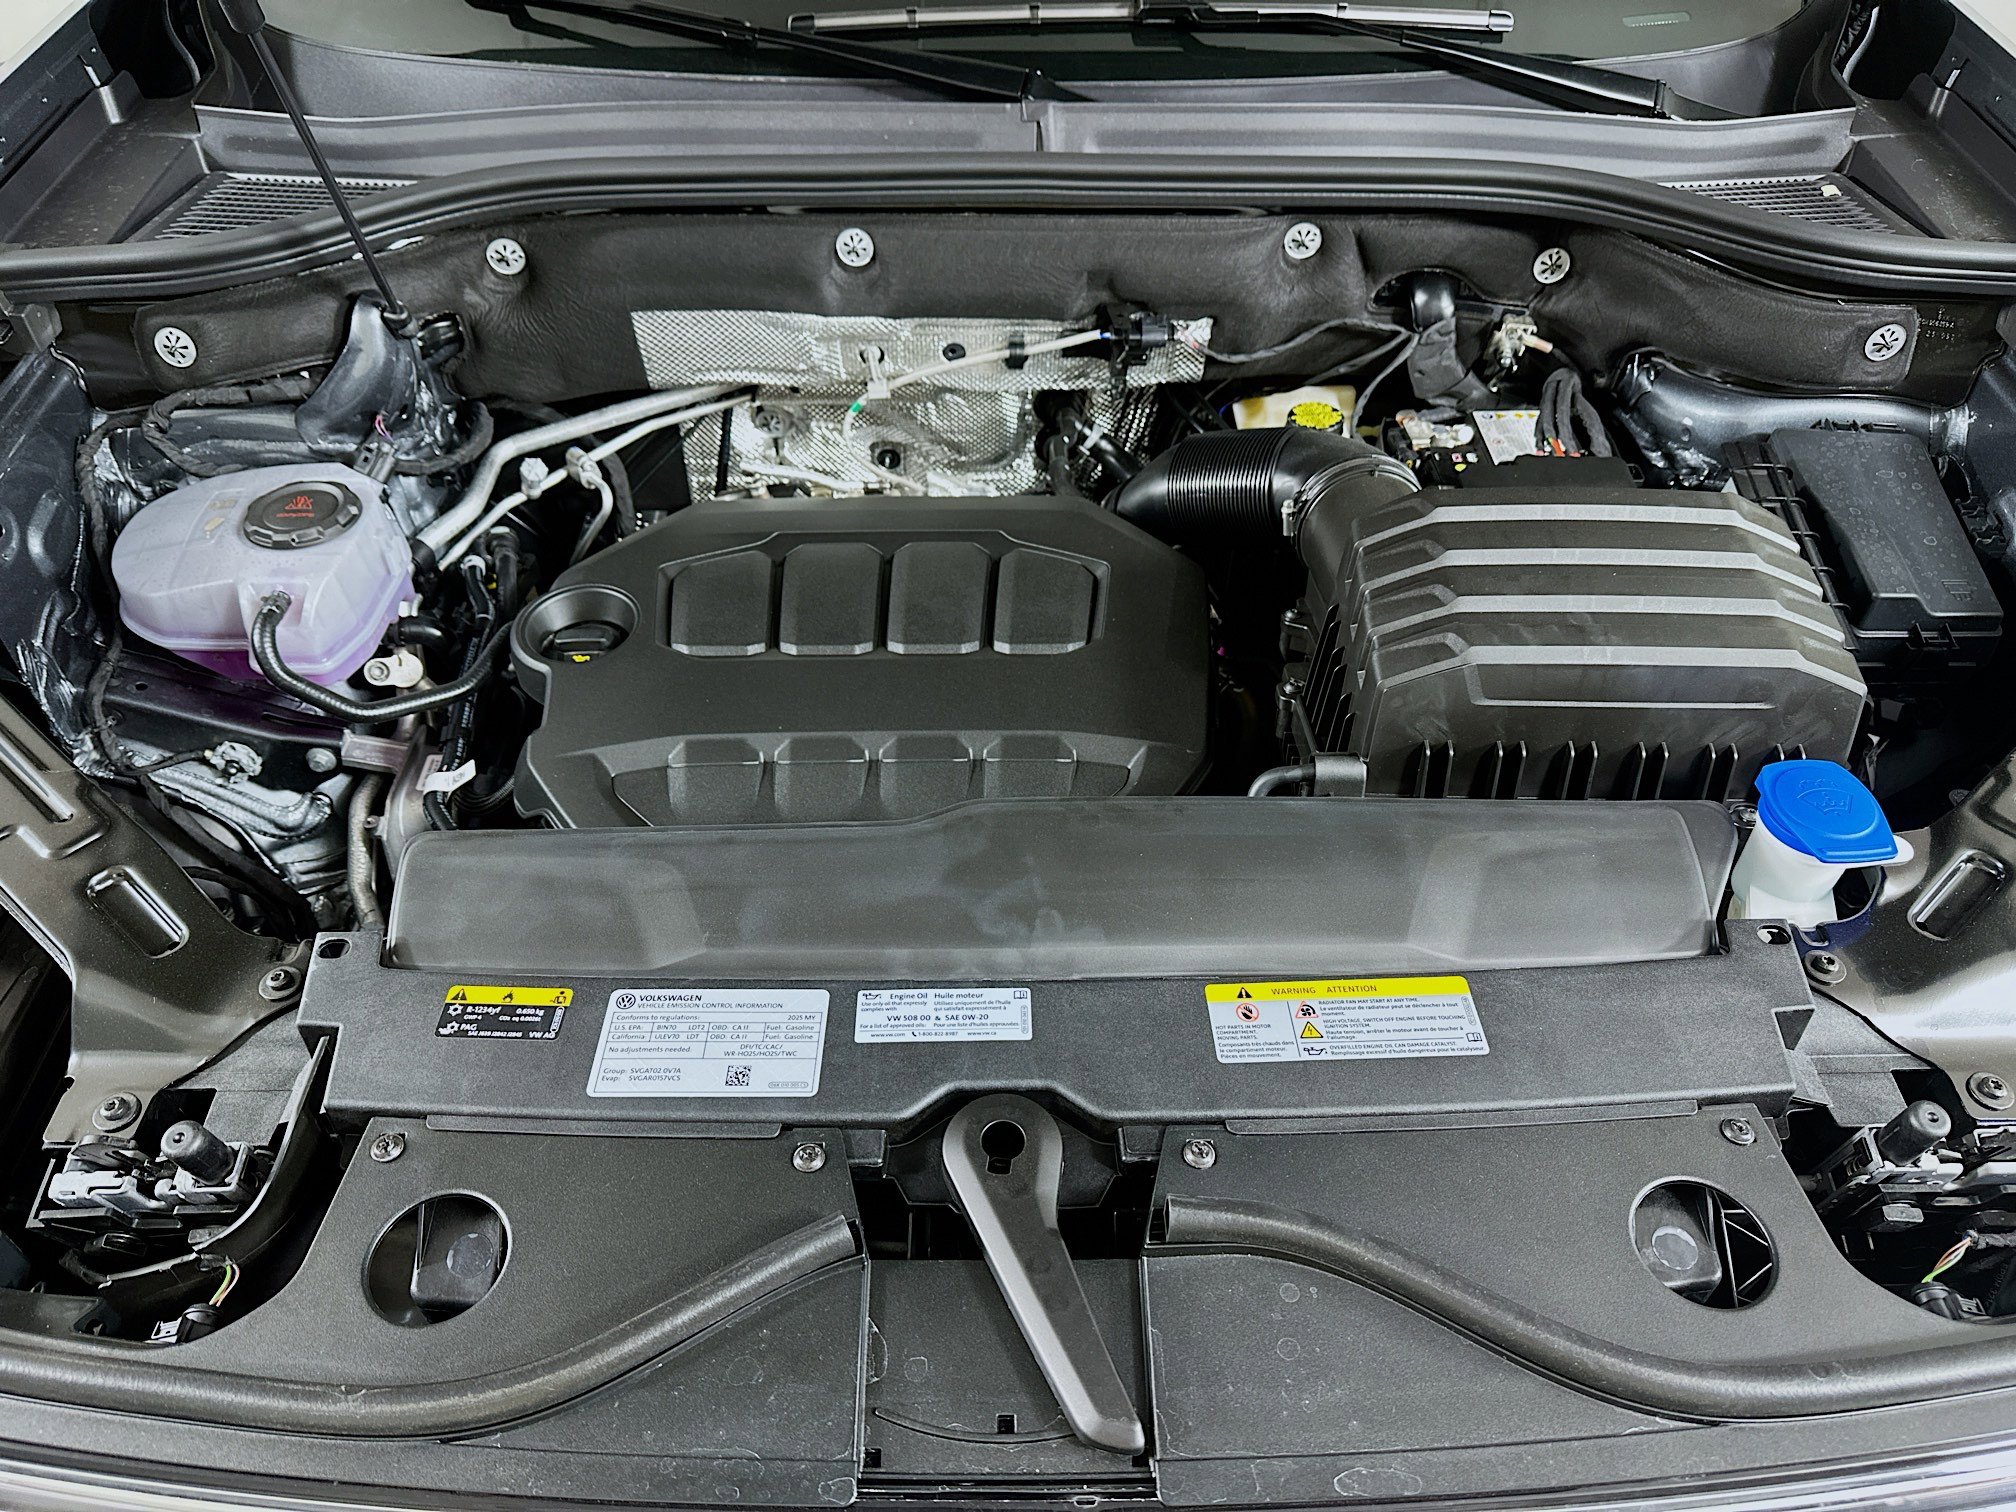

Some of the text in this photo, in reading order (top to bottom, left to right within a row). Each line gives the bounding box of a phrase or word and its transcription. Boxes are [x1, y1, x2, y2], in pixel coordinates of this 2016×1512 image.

[1271, 984, 1378, 995] WARNING ATTENTION
[890, 993, 915, 1001] Engine
[466, 1006, 502, 1015] R-1234yf
